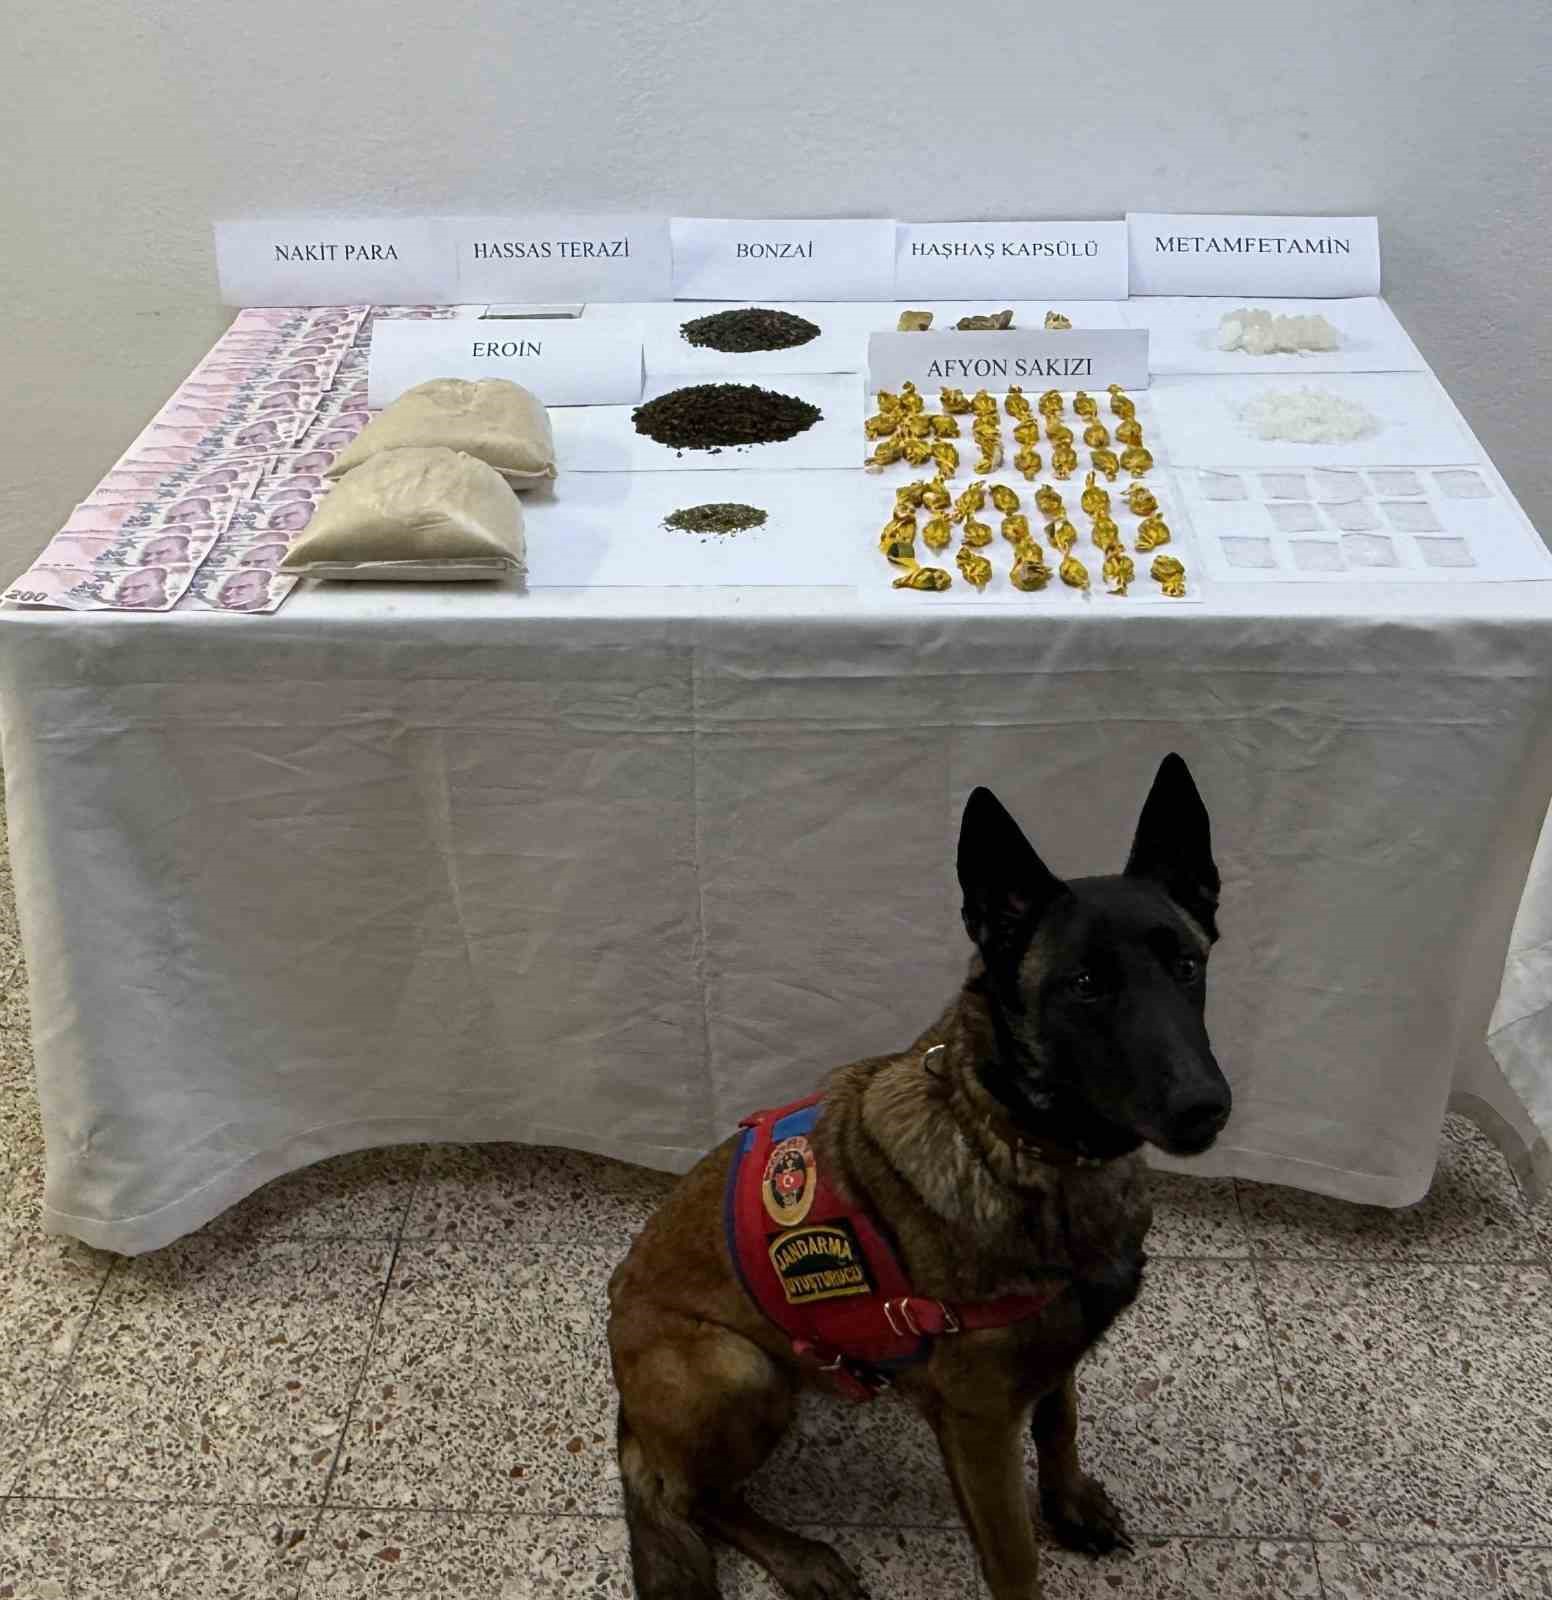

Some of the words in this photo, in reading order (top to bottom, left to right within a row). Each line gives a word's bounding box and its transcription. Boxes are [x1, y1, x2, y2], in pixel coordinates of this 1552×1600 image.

[274, 243, 338, 261] NAKİT
[344, 244, 399, 261] PARA
[473, 242, 552, 259] HASSAS
[556, 237, 630, 258] TERAZİ
[736, 239, 813, 259] BONZAİ
[911, 242, 995, 260] HAŞHAŞ
[1001, 240, 1099, 257] KAPSÜLÜ
[1155, 236, 1350, 256] METAMFETAMİN
[471, 339, 543, 358] EROİN
[927, 359, 1008, 378] AFYON
[1015, 358, 1093, 377] SAKIZI
[5, 590, 48, 602] 200
[777, 1236, 854, 1270] JANDARMA
